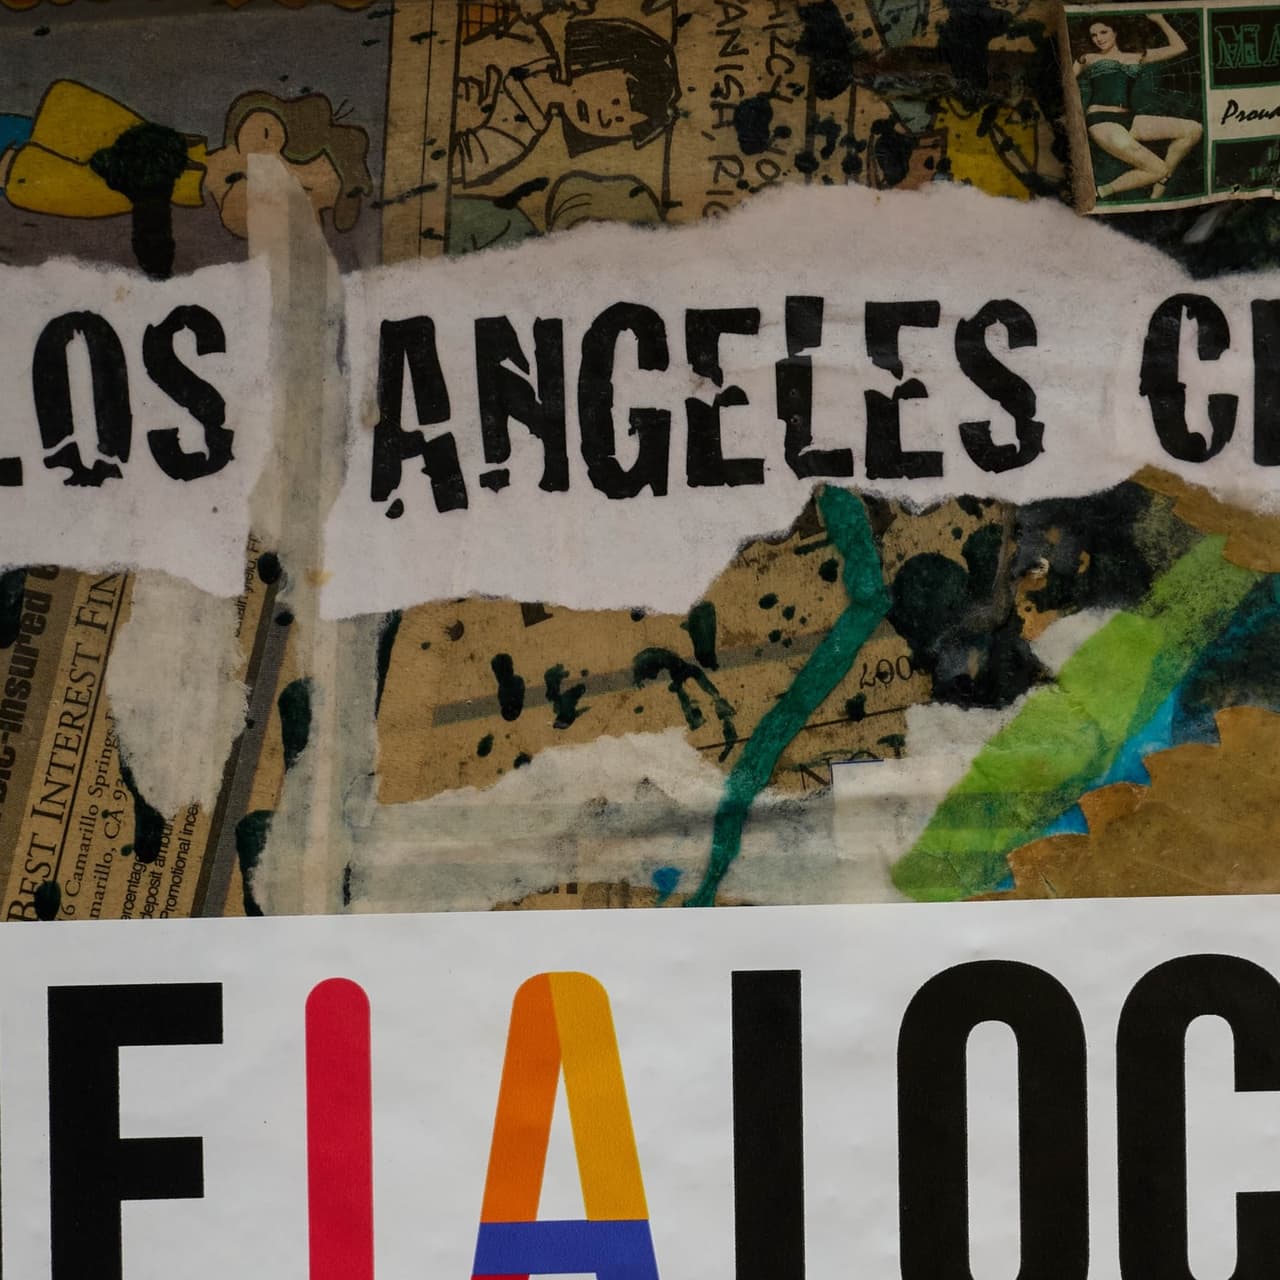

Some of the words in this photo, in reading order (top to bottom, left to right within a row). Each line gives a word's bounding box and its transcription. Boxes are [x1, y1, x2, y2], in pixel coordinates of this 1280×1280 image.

[369, 293, 1045, 518] ANGELES
[29, 642, 103, 825] INTEREST
[87, 724, 120, 798] Springs
[63, 802, 99, 898] Camarillo
